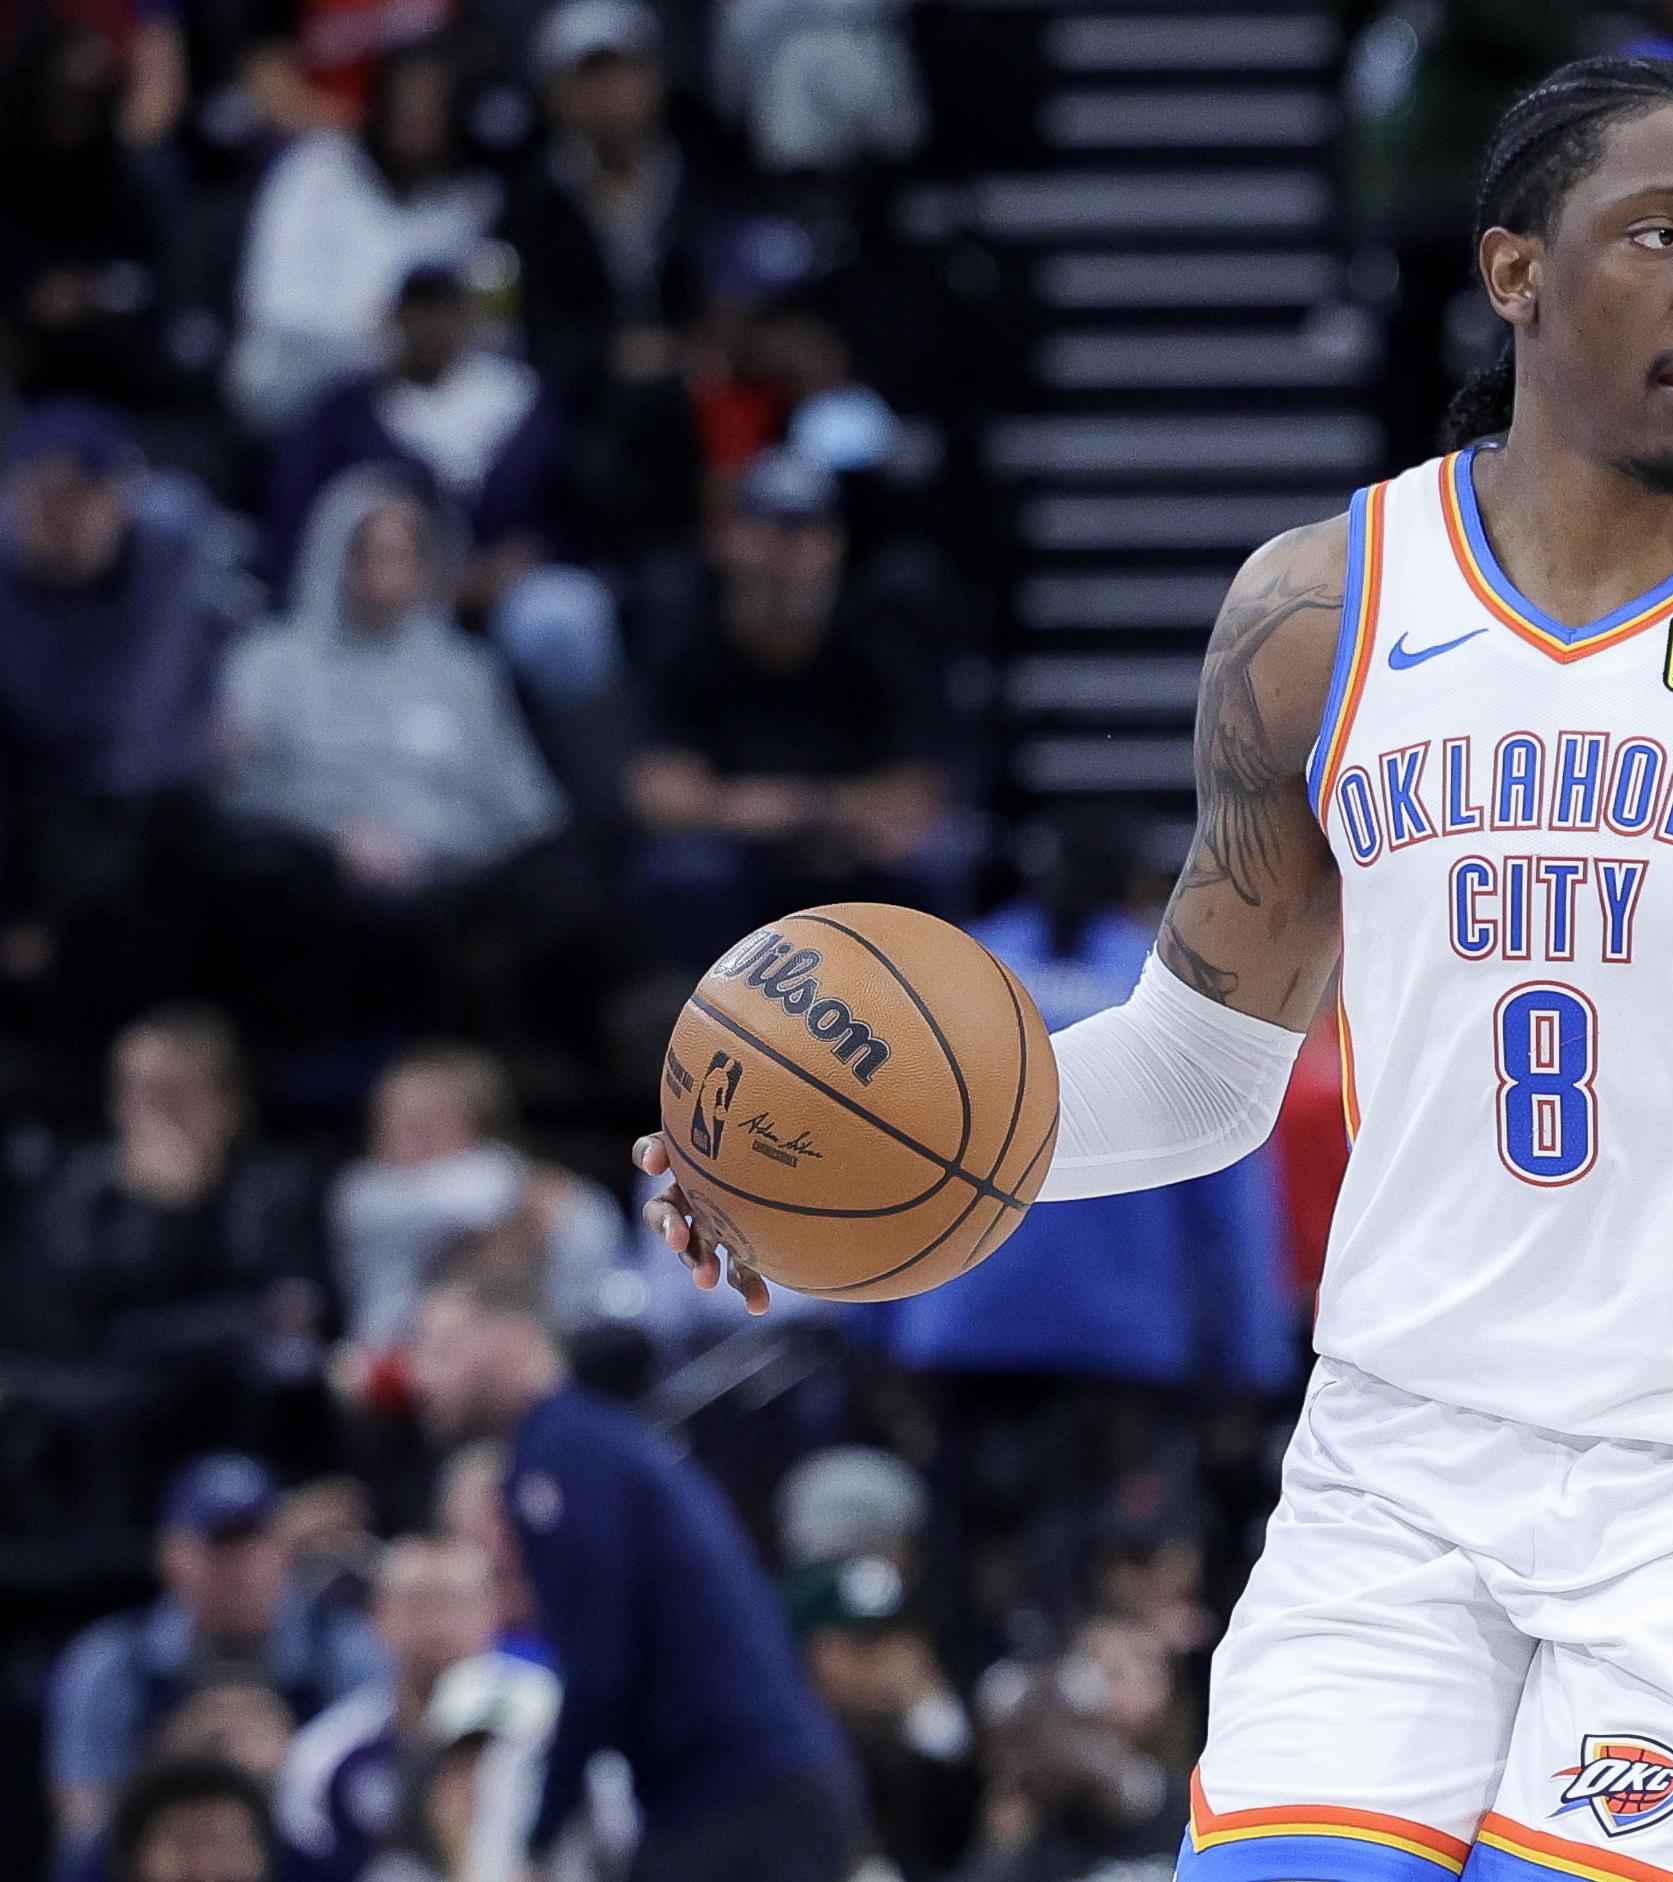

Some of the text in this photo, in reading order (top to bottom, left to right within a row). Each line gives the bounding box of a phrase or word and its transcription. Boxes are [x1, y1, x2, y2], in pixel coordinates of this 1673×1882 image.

[1449, 855, 1649, 963] CITY
[711, 928, 891, 1087] Wilson
[1494, 980, 1599, 1187] 8
